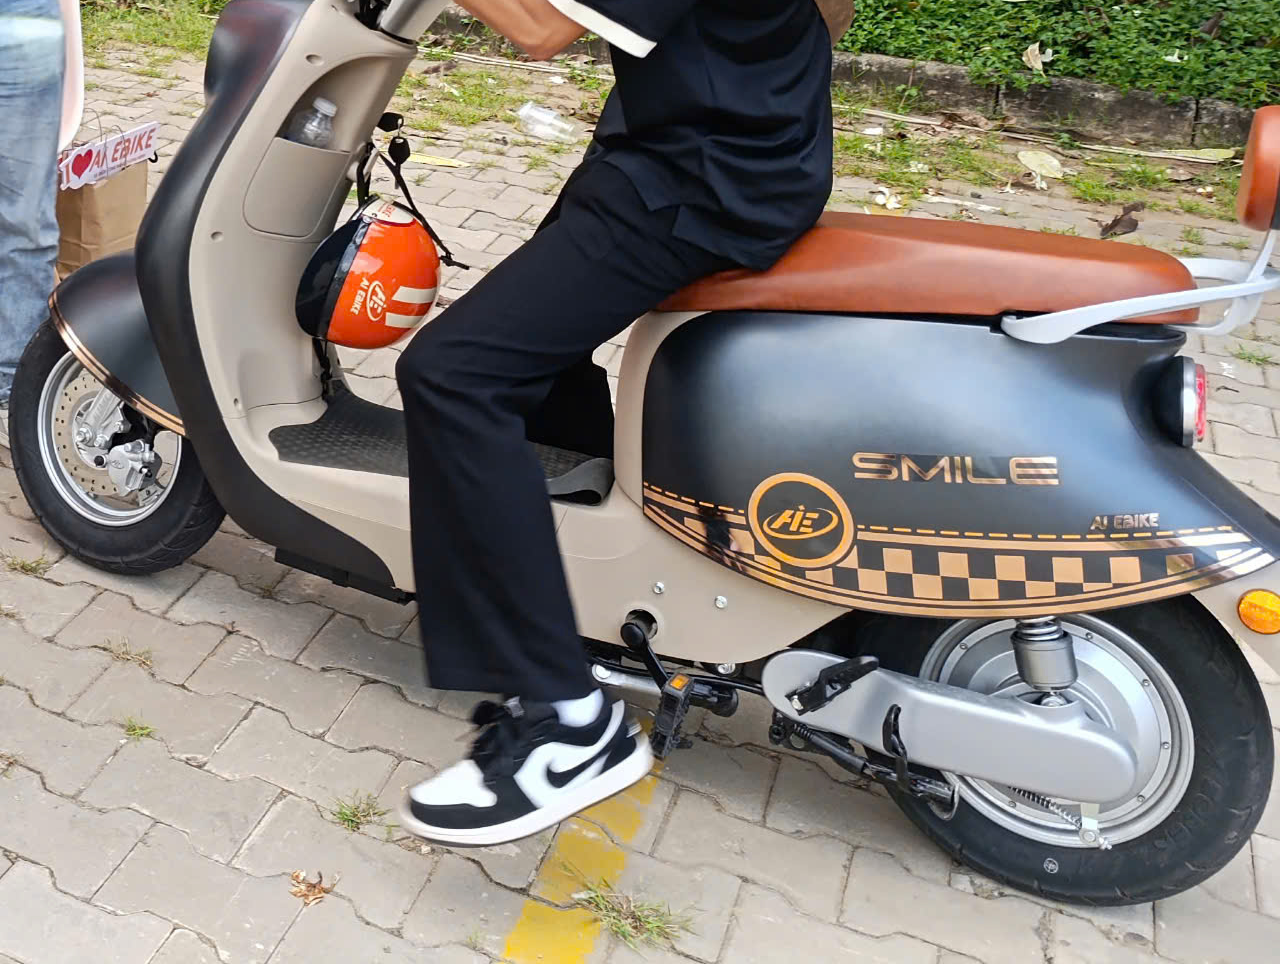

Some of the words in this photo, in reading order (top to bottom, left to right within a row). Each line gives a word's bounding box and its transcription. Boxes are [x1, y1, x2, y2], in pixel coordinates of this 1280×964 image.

[111, 127, 157, 163] EBIKE
[350, 290, 366, 315] EBIKE
[852, 451, 1060, 485] SMILE
[1090, 516, 1108, 530] AI
[1114, 512, 1160, 529] EBIKE
